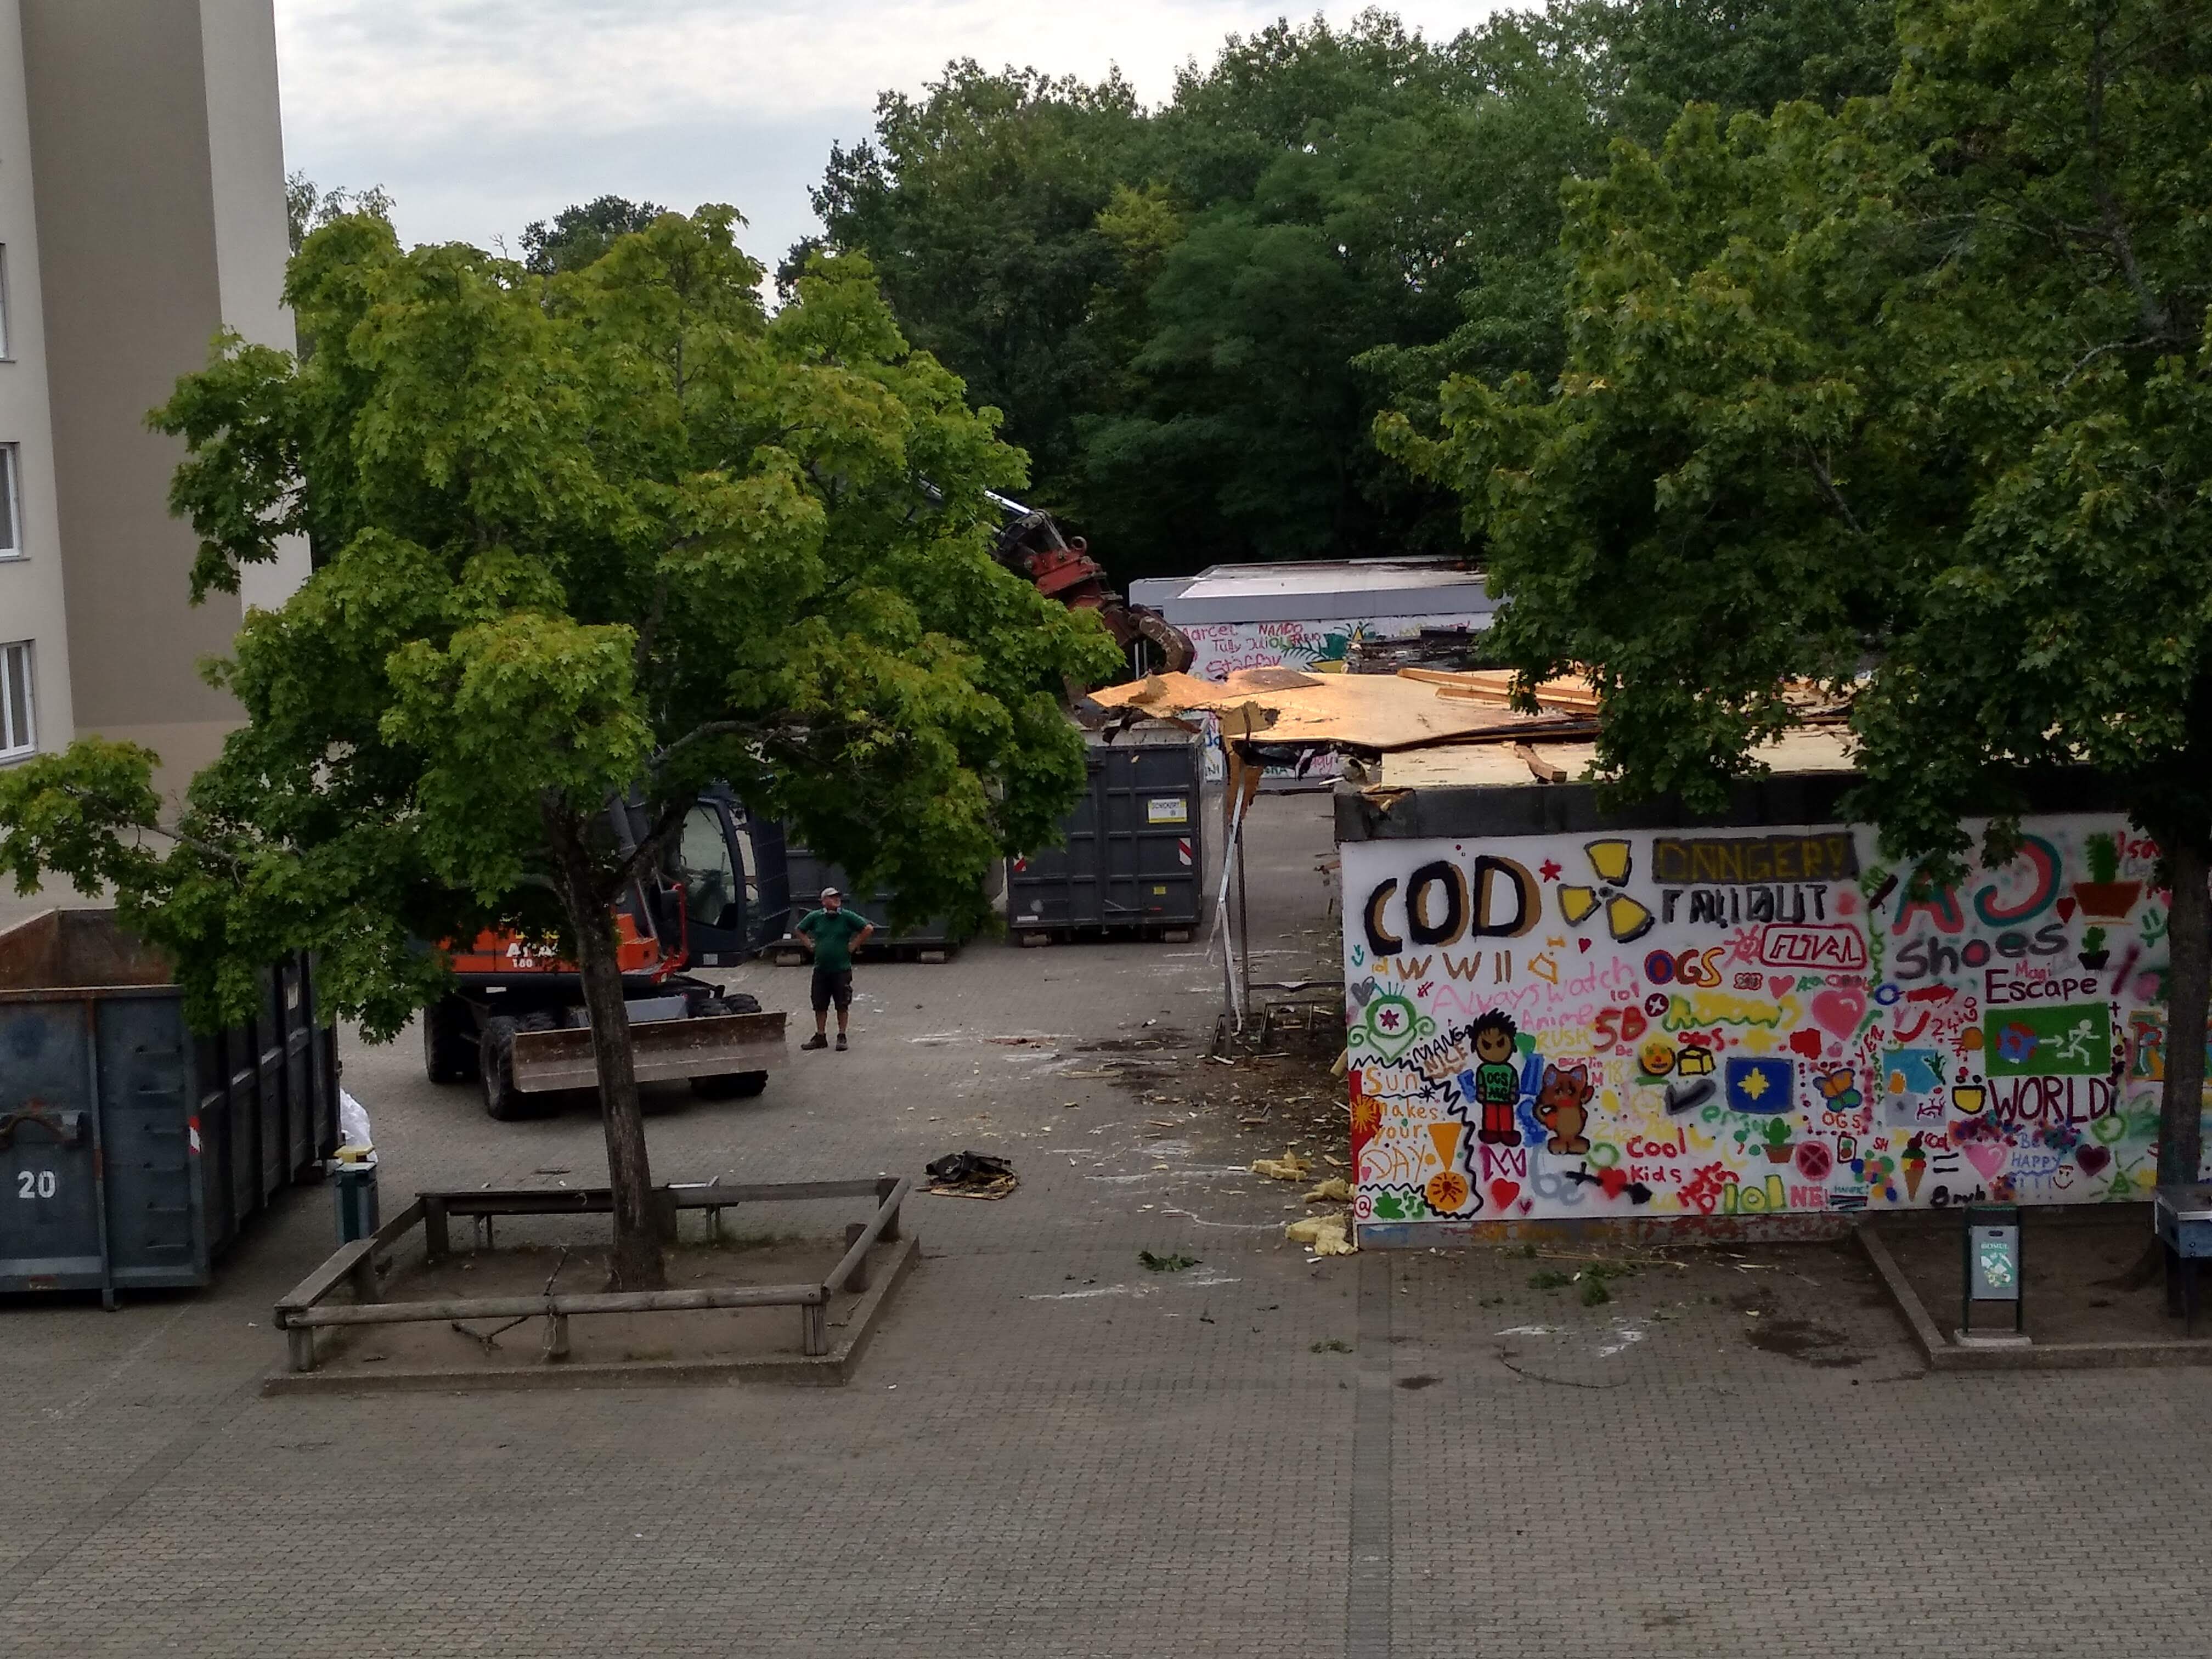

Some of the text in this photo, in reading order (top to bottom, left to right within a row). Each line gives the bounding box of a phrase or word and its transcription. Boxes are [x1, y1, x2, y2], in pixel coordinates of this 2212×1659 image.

[1364, 855, 1542, 957] COD
[1644, 947, 1725, 988] OGS
[1894, 923, 2069, 980] Shoes
[1985, 968, 2097, 1004] Escape
[1522, 1005, 1593, 1030] Anime
[1366, 1066, 1418, 1094] Sun
[1374, 1097, 1438, 1121] makes
[1987, 1076, 2110, 1121] WORLD
[18, 1171, 57, 1198] 20
